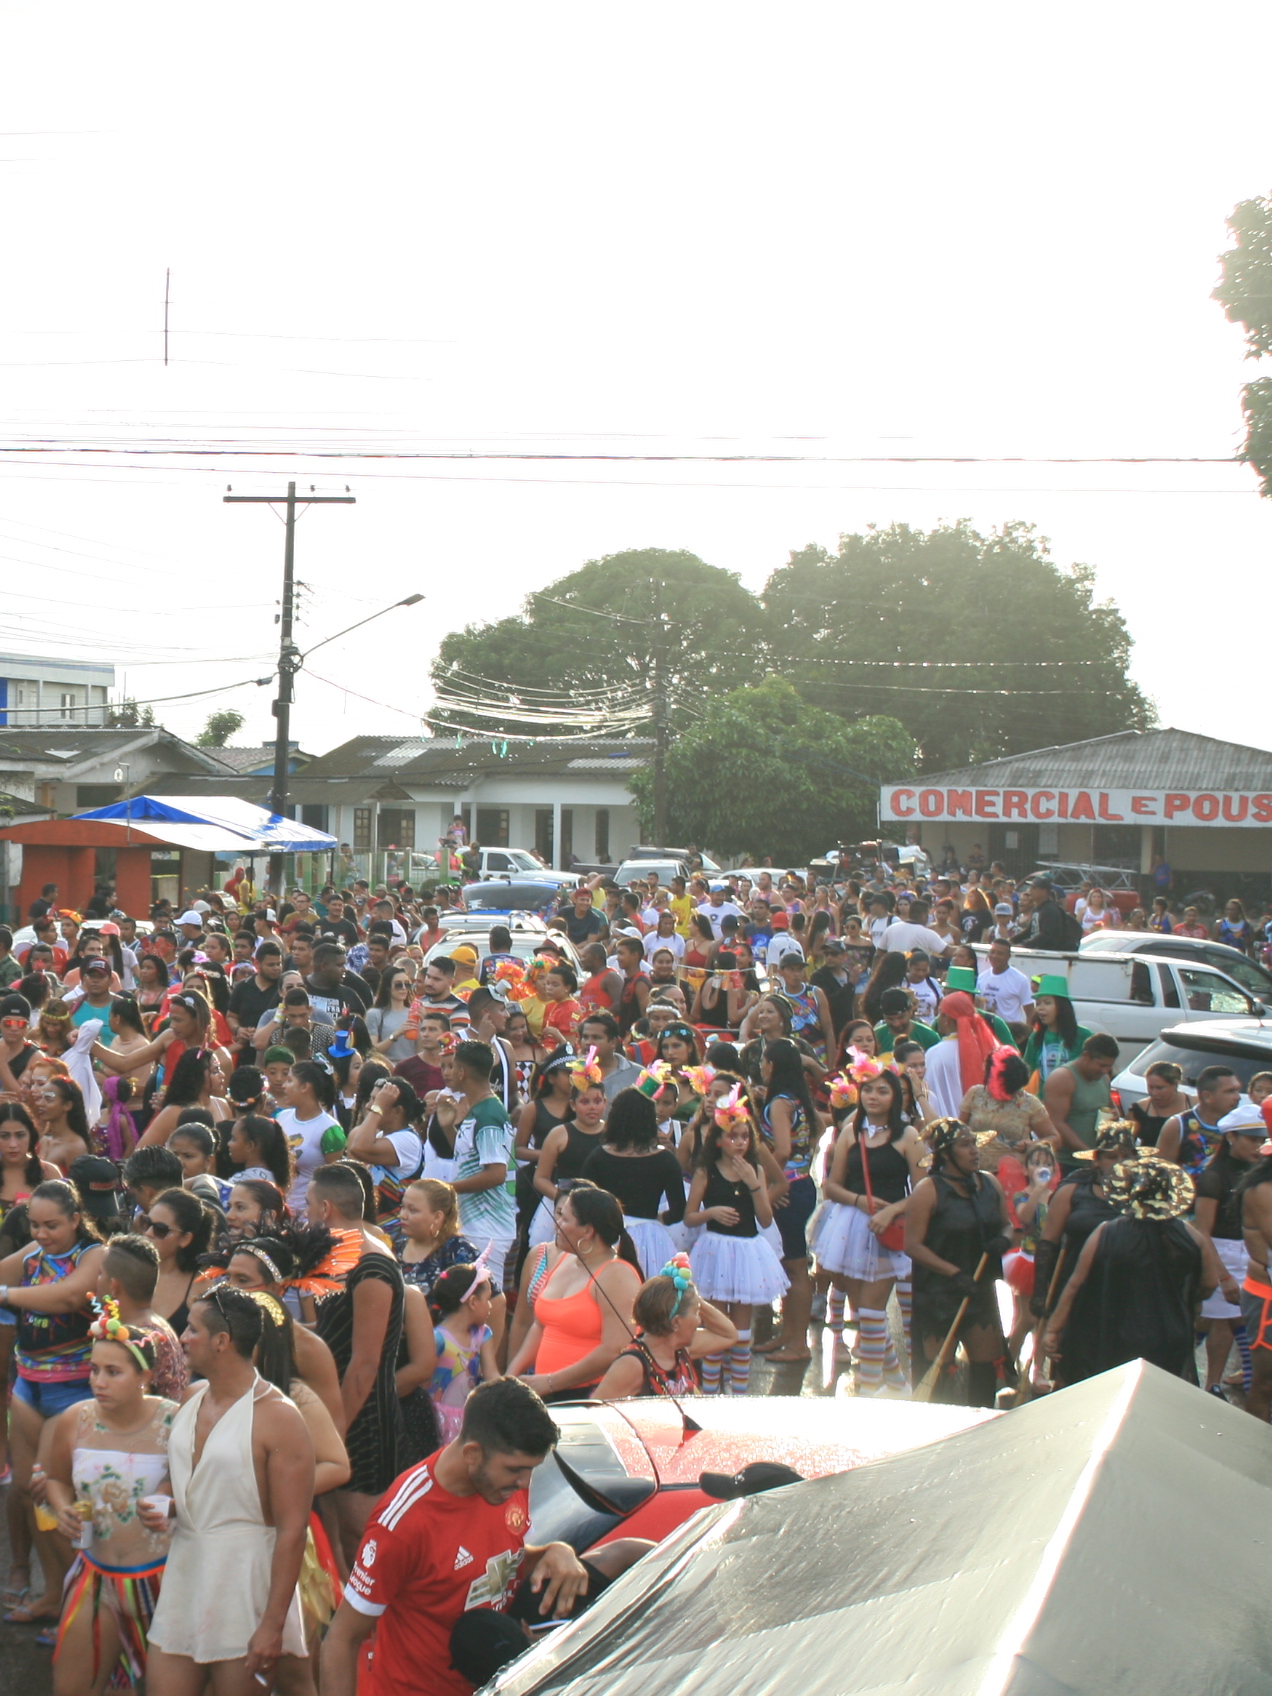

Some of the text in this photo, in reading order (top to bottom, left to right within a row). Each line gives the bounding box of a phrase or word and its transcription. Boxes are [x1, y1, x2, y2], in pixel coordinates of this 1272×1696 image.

[890, 788, 1272, 823] COMERCIAL E POUS
